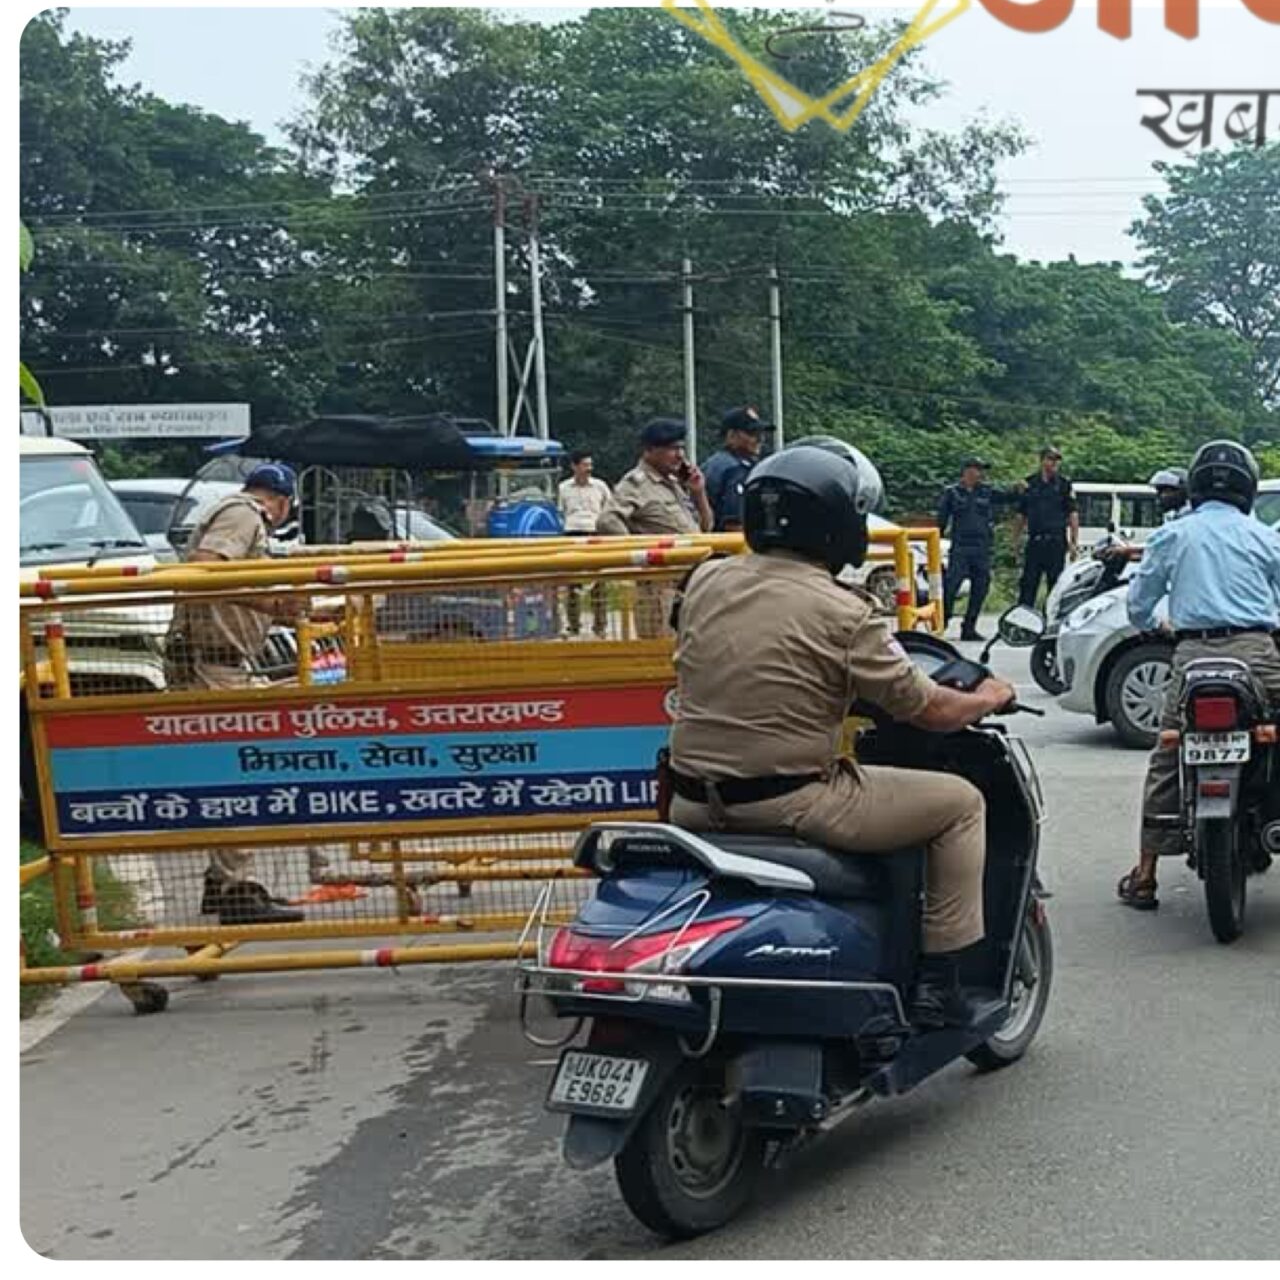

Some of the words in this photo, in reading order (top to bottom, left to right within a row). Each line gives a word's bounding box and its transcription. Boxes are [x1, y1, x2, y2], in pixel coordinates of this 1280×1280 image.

[146, 710, 281, 735] यातायात
[288, 703, 399, 738] पुलिस,
[408, 699, 566, 726] उत्तराखण्ड
[237, 745, 349, 773] मित्रता,
[360, 740, 438, 770] सेवा,
[449, 741, 537, 770] सुरक्षा
[69, 793, 150, 824] बच्चों
[153, 793, 190, 820] के
[199, 795, 260, 818] हाथ
[267, 787, 301, 815] में
[400, 781, 486, 810] खतरे
[492, 778, 524, 808] में
[530, 775, 616, 807] रहेगी
[575, 1056, 636, 1083] UK04A
